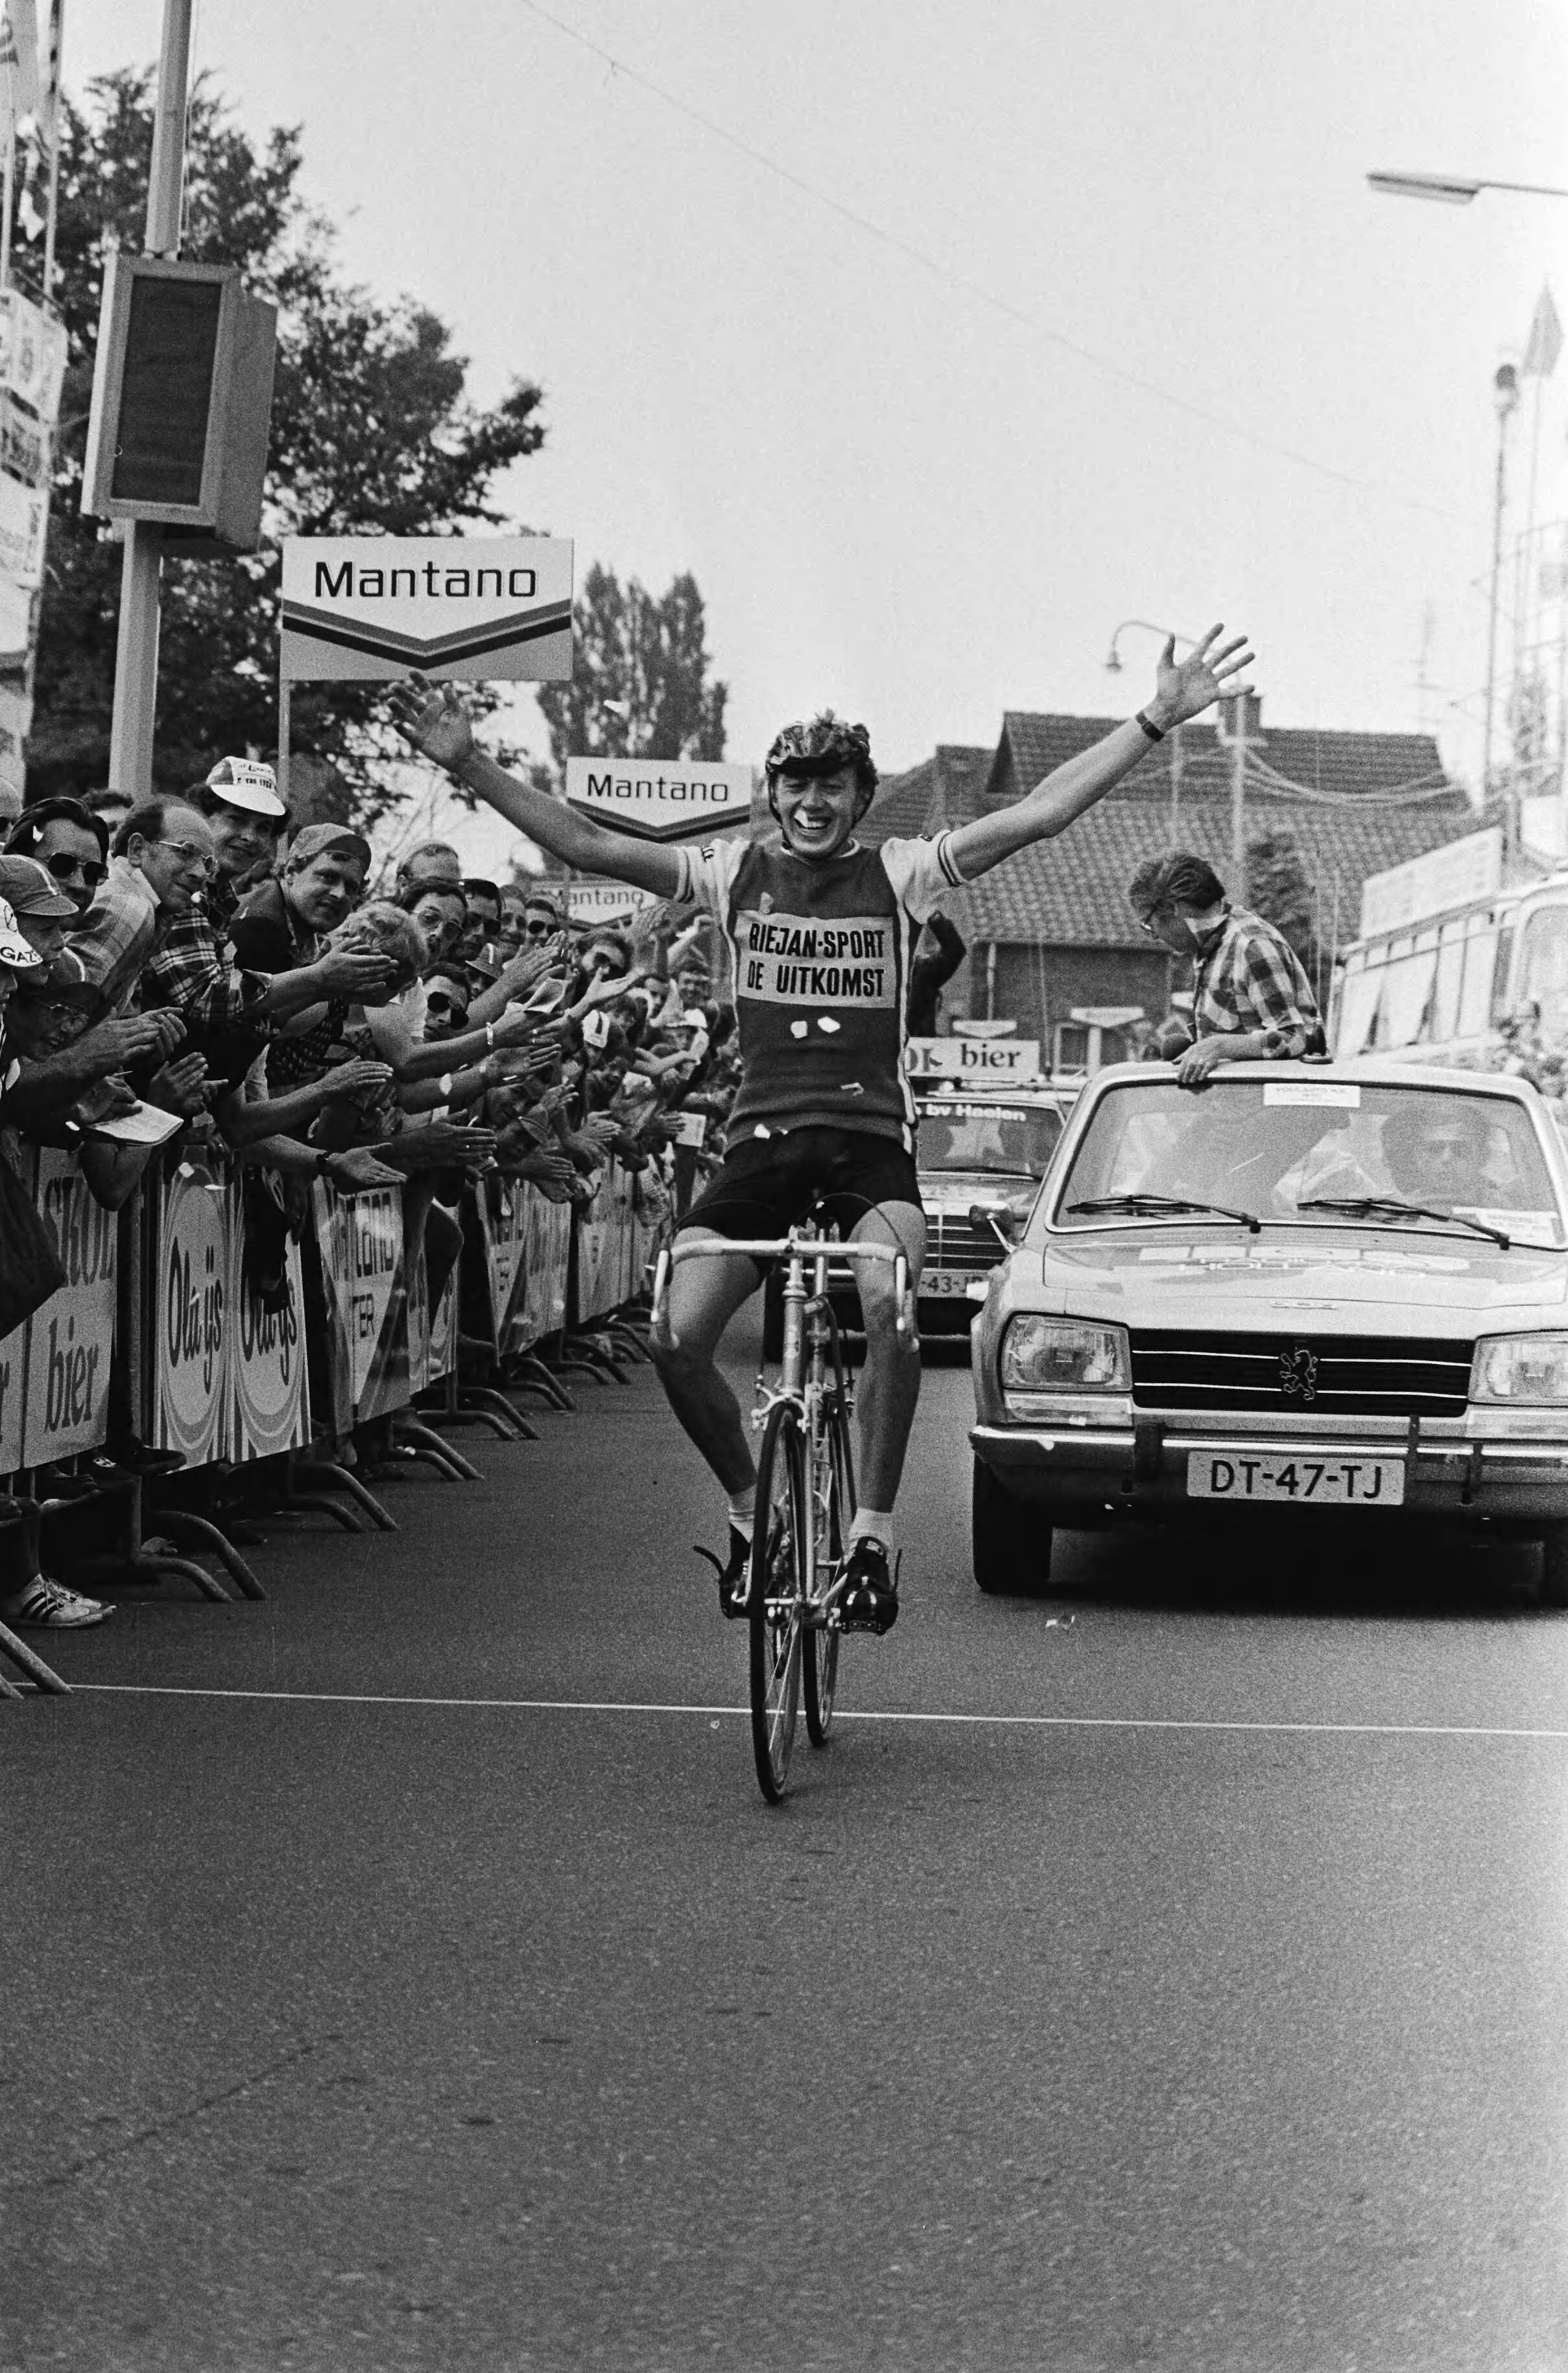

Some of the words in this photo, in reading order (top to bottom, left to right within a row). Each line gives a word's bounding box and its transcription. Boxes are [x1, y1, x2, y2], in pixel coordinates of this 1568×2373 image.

[315, 561, 536, 597] Mantano
[588, 774, 728, 802] Mantano
[551, 888, 643, 906] antano
[747, 960, 765, 990] DE
[776, 964, 885, 997] UITKOMST
[960, 1043, 1021, 1068] bier
[168, 1235, 204, 1368] Ola
[45, 1315, 99, 1433] bier
[1211, 1459, 1382, 1499] DT-47-TJ
